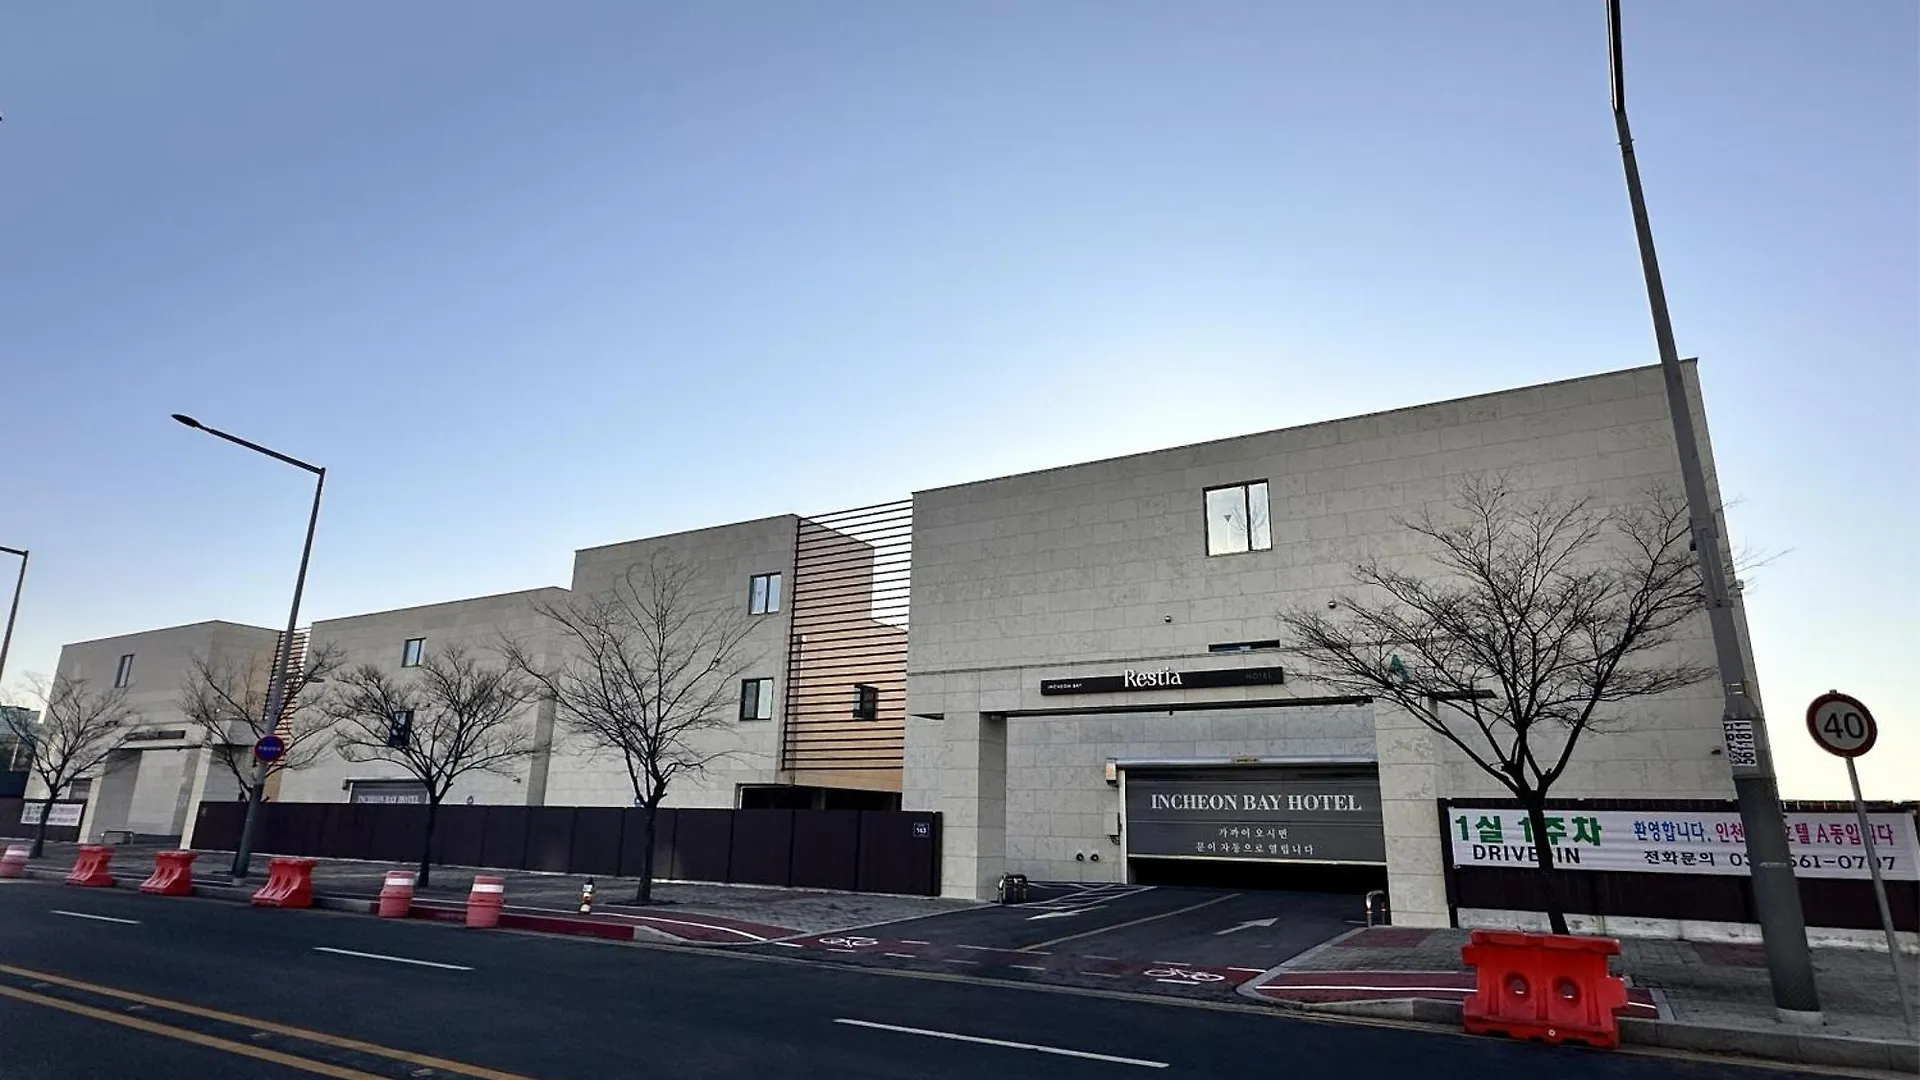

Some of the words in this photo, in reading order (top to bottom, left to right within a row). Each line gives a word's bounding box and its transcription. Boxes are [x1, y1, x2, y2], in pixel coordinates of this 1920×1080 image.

[1124, 667, 1183, 688] Restia
[1824, 712, 1865, 740] 40
[1151, 793, 1238, 810] INCHEON
[1243, 794, 1282, 811] BAY
[1288, 794, 1362, 811] HOTEL
[1219, 827, 1250, 839] 가까이
[1255, 827, 1288, 840] 오시면
[1455, 815, 1504, 844] 1실
[1634, 820, 1712, 843] 환영합니다.
[1220, 842, 1264, 853] 자동으로
[1644, 850, 1715, 867] 전화문의
